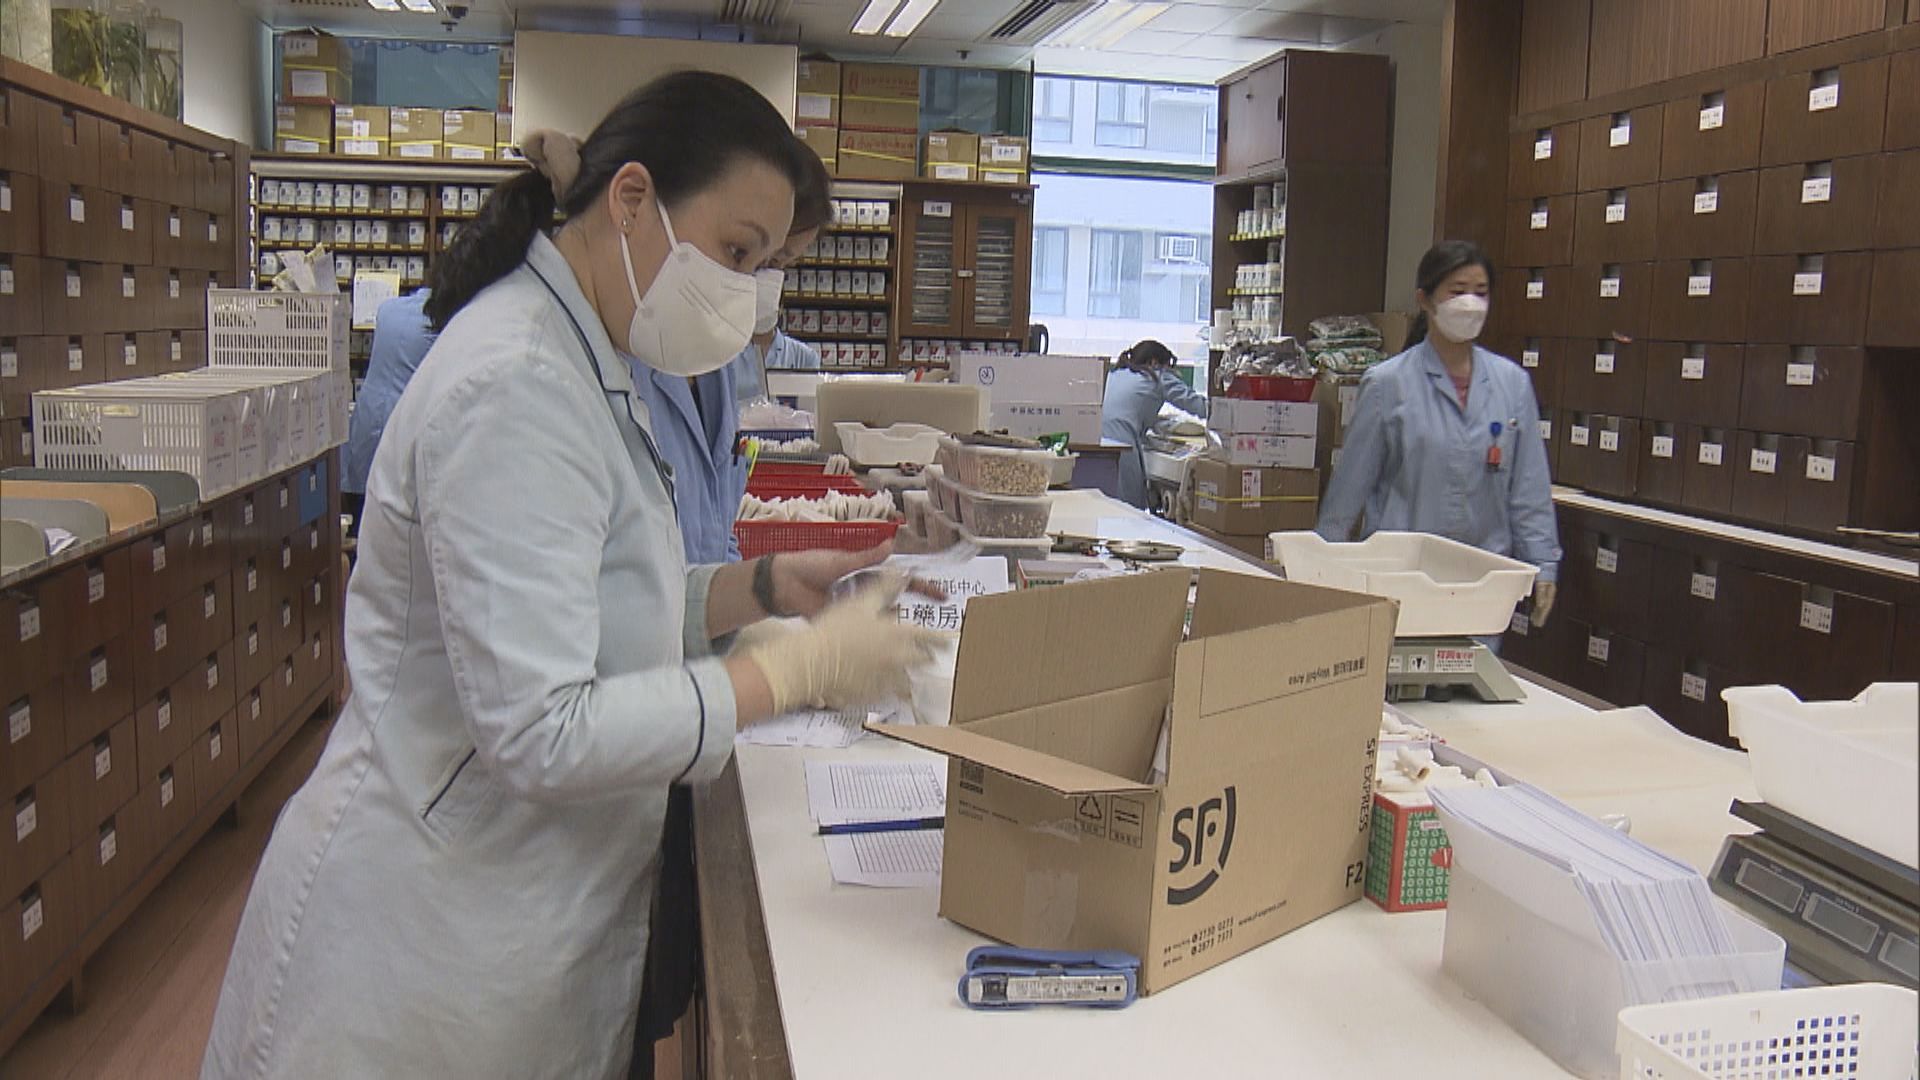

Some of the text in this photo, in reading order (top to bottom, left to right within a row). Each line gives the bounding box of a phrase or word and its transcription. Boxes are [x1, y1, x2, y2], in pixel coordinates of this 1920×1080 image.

[1359, 738, 1376, 832] SF EXPRESS
[1345, 861, 1364, 888] F2
